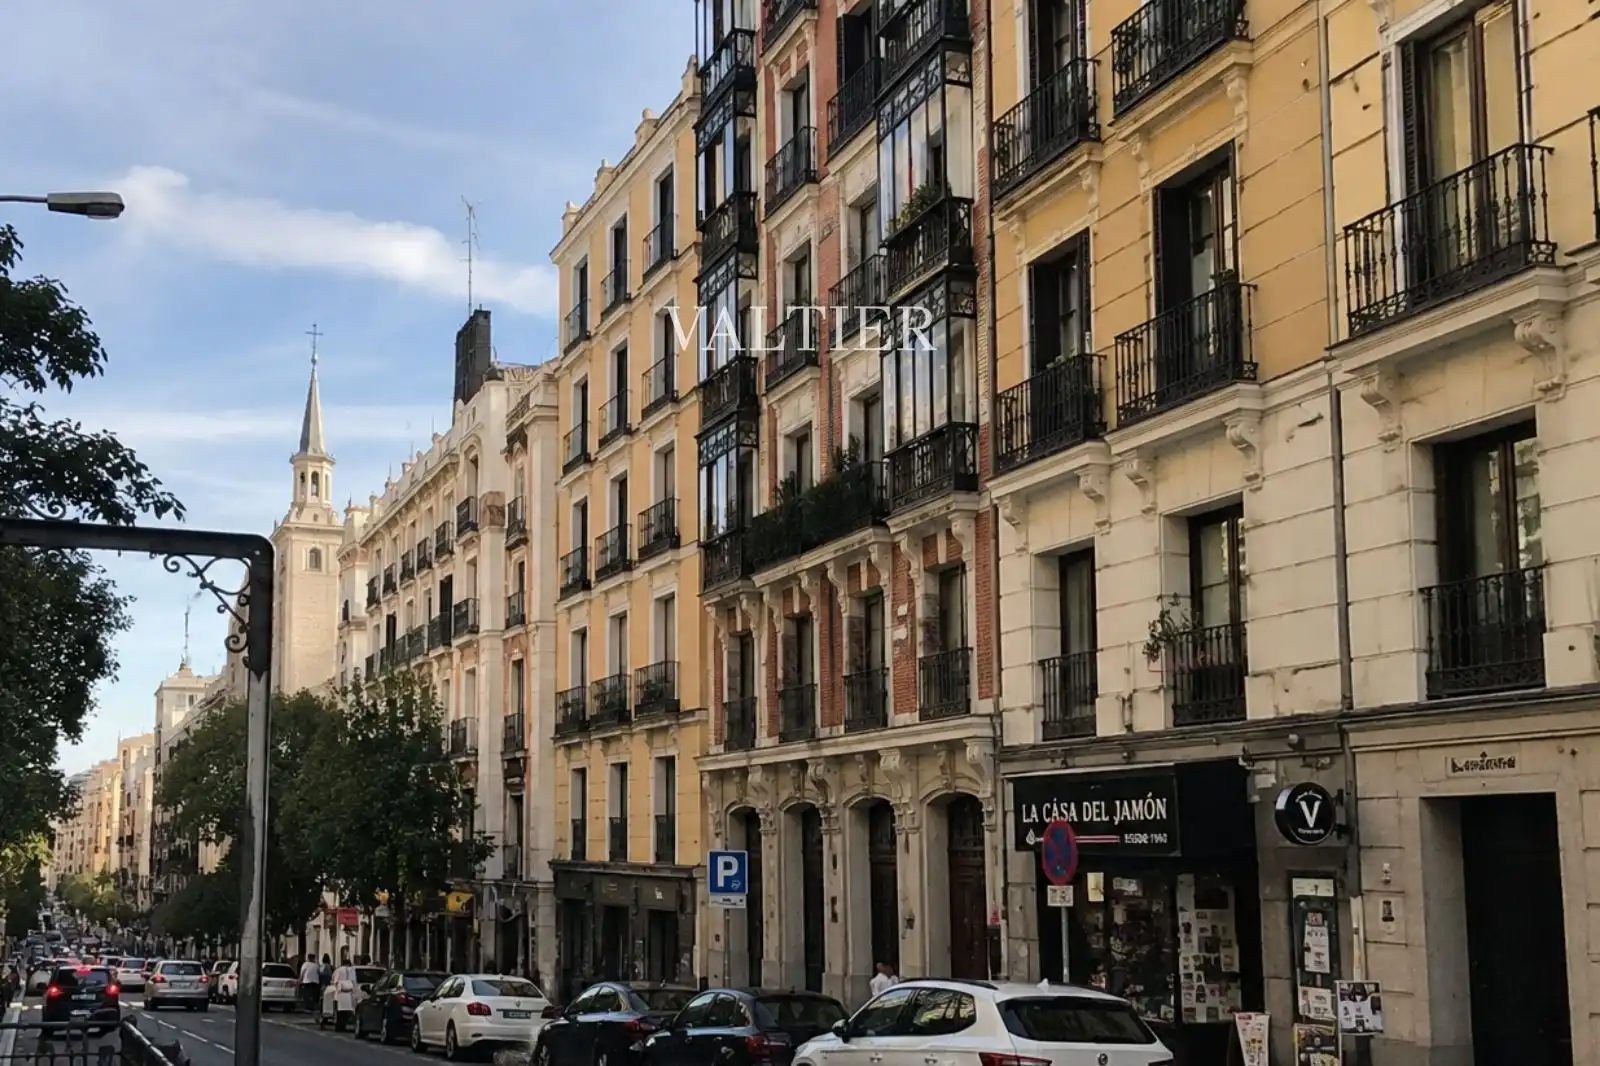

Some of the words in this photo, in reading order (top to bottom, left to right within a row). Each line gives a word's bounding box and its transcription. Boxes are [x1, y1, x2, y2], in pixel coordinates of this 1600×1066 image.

[1022, 804, 1039, 823] LA
[1082, 800, 1109, 822] DEL
[1113, 792, 1167, 825] JAMÓN
[1299, 801, 1321, 828] V
[718, 855, 738, 887] P
